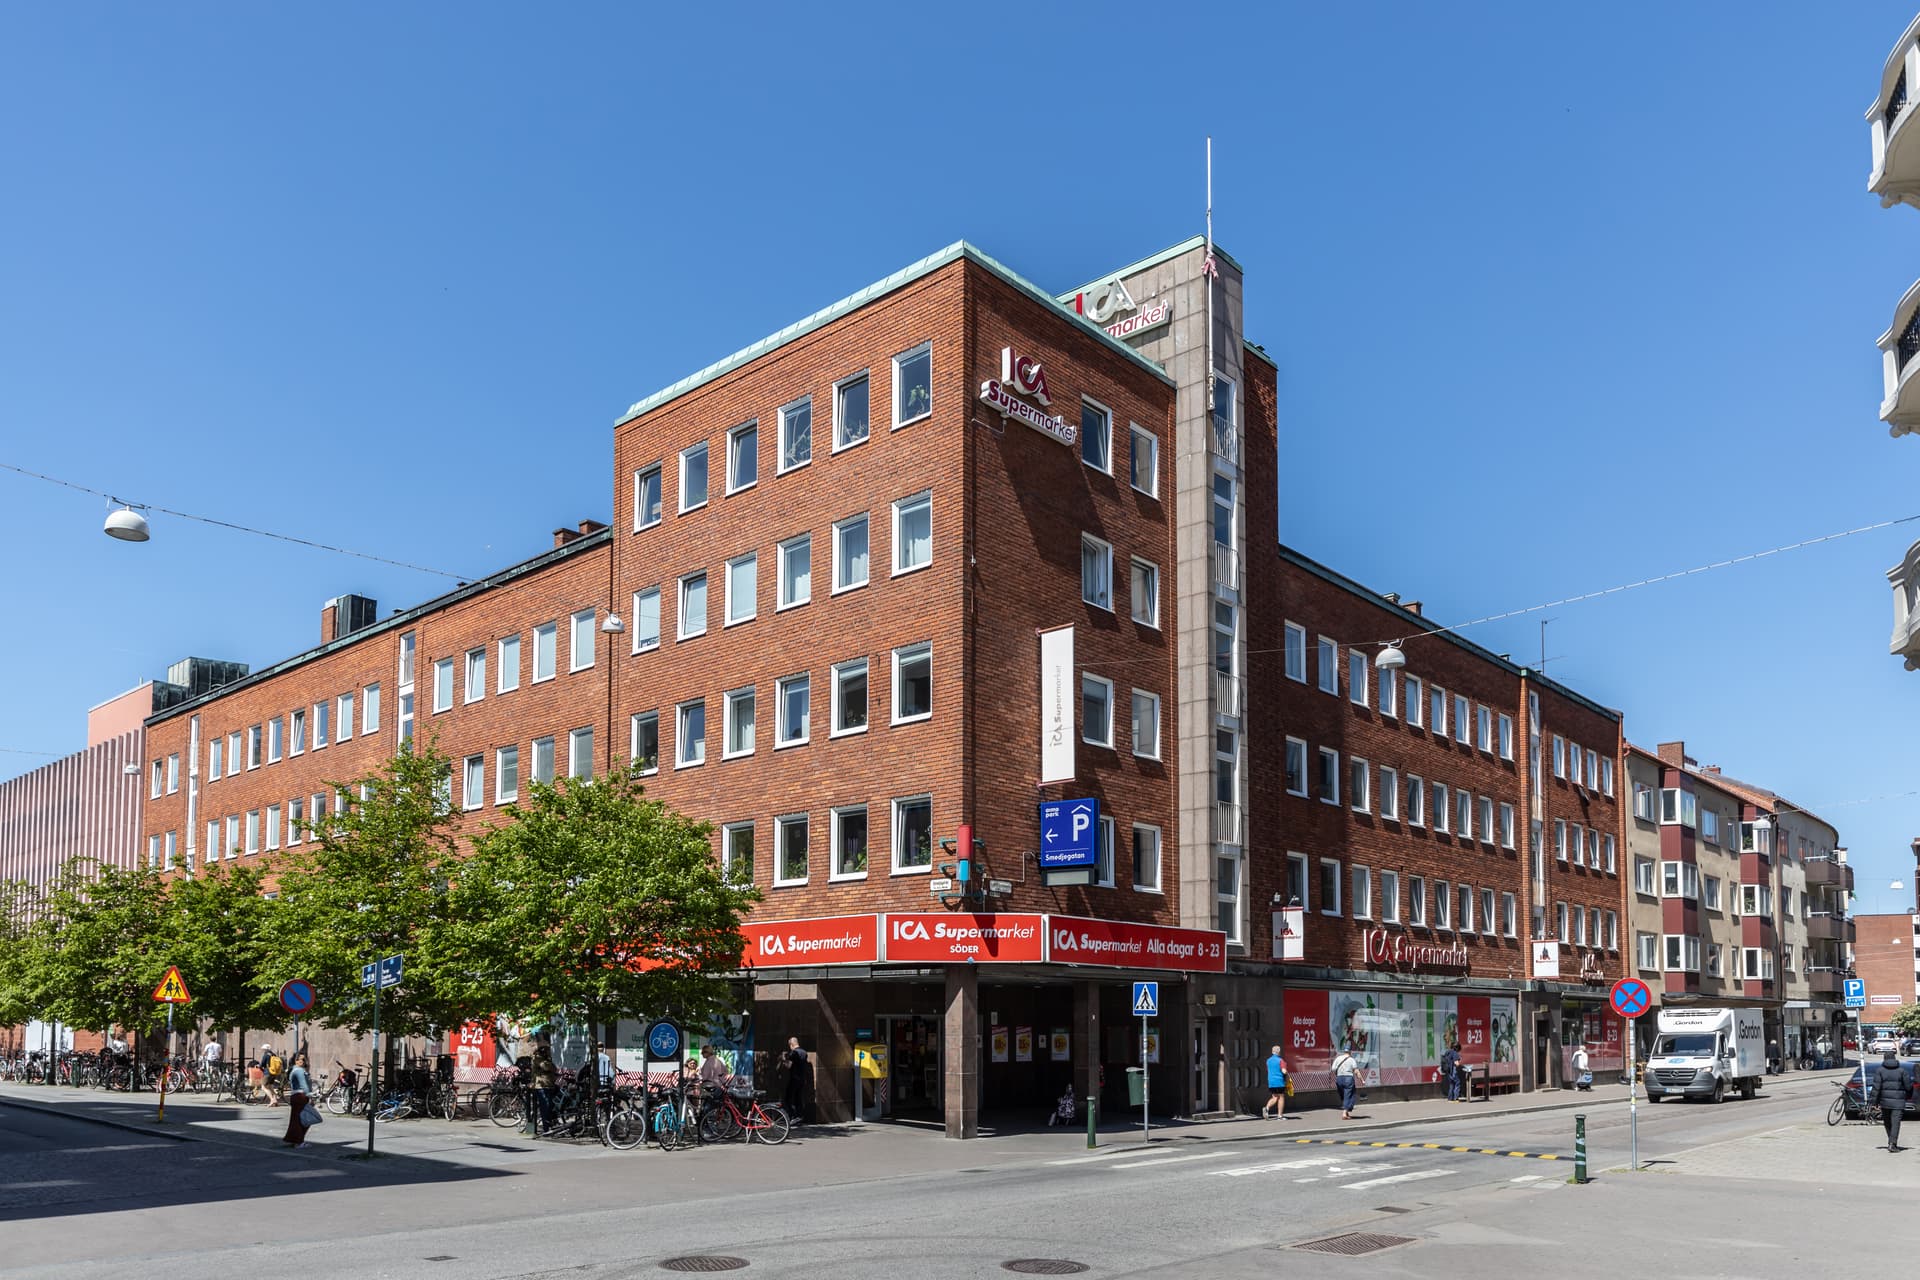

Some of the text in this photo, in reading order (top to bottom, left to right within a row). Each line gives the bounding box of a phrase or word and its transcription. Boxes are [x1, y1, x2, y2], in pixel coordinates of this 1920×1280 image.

[1003, 347, 1051, 405] ICA
[988, 380, 1078, 442] Supermarket
[1073, 813, 1090, 842] P
[1045, 852, 1086, 862] Smedjegatan
[893, 920, 1034, 942] ICA Supermarket
[759, 931, 862, 955] ICA Supermarket
[949, 942, 979, 954] SÖDER
[1053, 929, 1078, 951] ICA
[1079, 932, 1142, 954] Supermarket
[1147, 938, 1165, 953] Alla
[1166, 939, 1194, 959] dagar
[1363, 929, 1467, 969] ICA Supermarket
[1849, 981, 1860, 996] P
[1293, 1016, 1302, 1025] Alla
[1738, 1019, 1761, 1040] .Gordon
